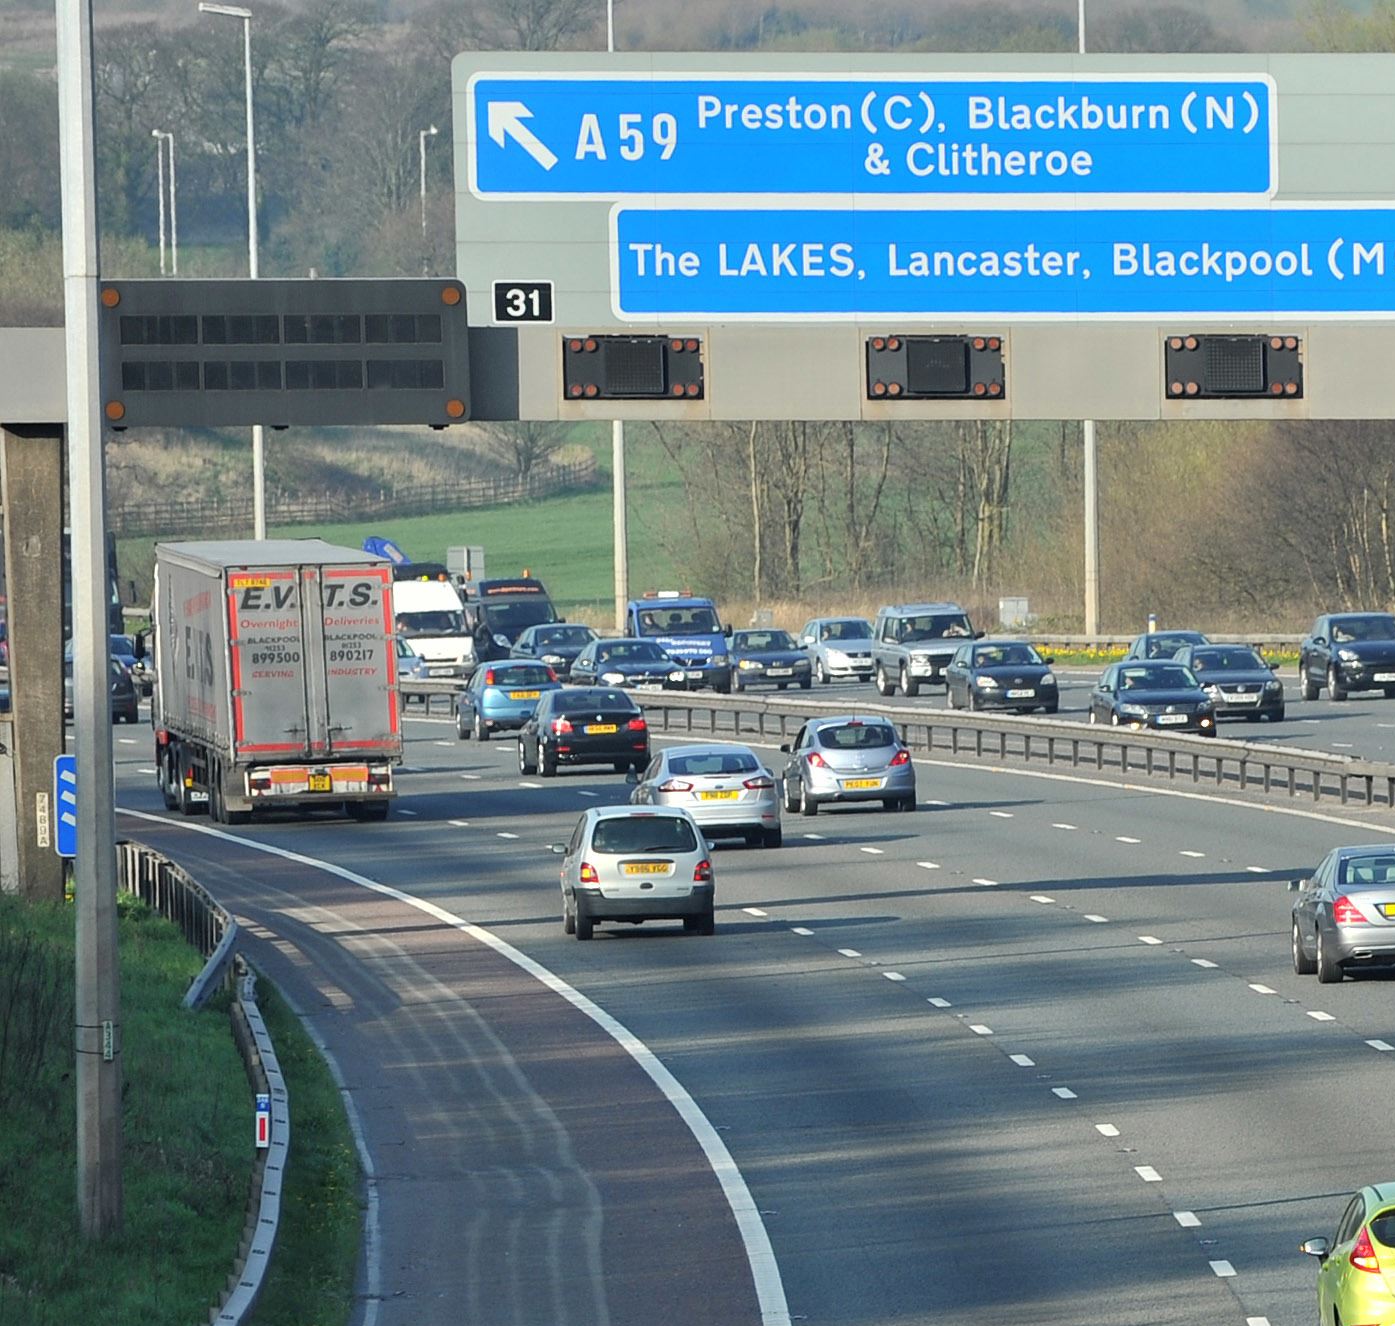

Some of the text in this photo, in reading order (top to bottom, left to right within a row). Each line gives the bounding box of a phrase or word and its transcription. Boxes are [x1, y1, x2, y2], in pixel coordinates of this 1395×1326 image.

[864, 141, 1093, 177] & Clitheroe
[629, 243, 700, 277] The
[719, 243, 866, 280] LAKES,
[889, 243, 1091, 280] Lancaster,
[1113, 242, 1313, 282] Blackpool
[505, 288, 540, 317] 31
[240, 616, 380, 631] Overnight Deliveries
[252, 650, 374, 664] 899500 890217
